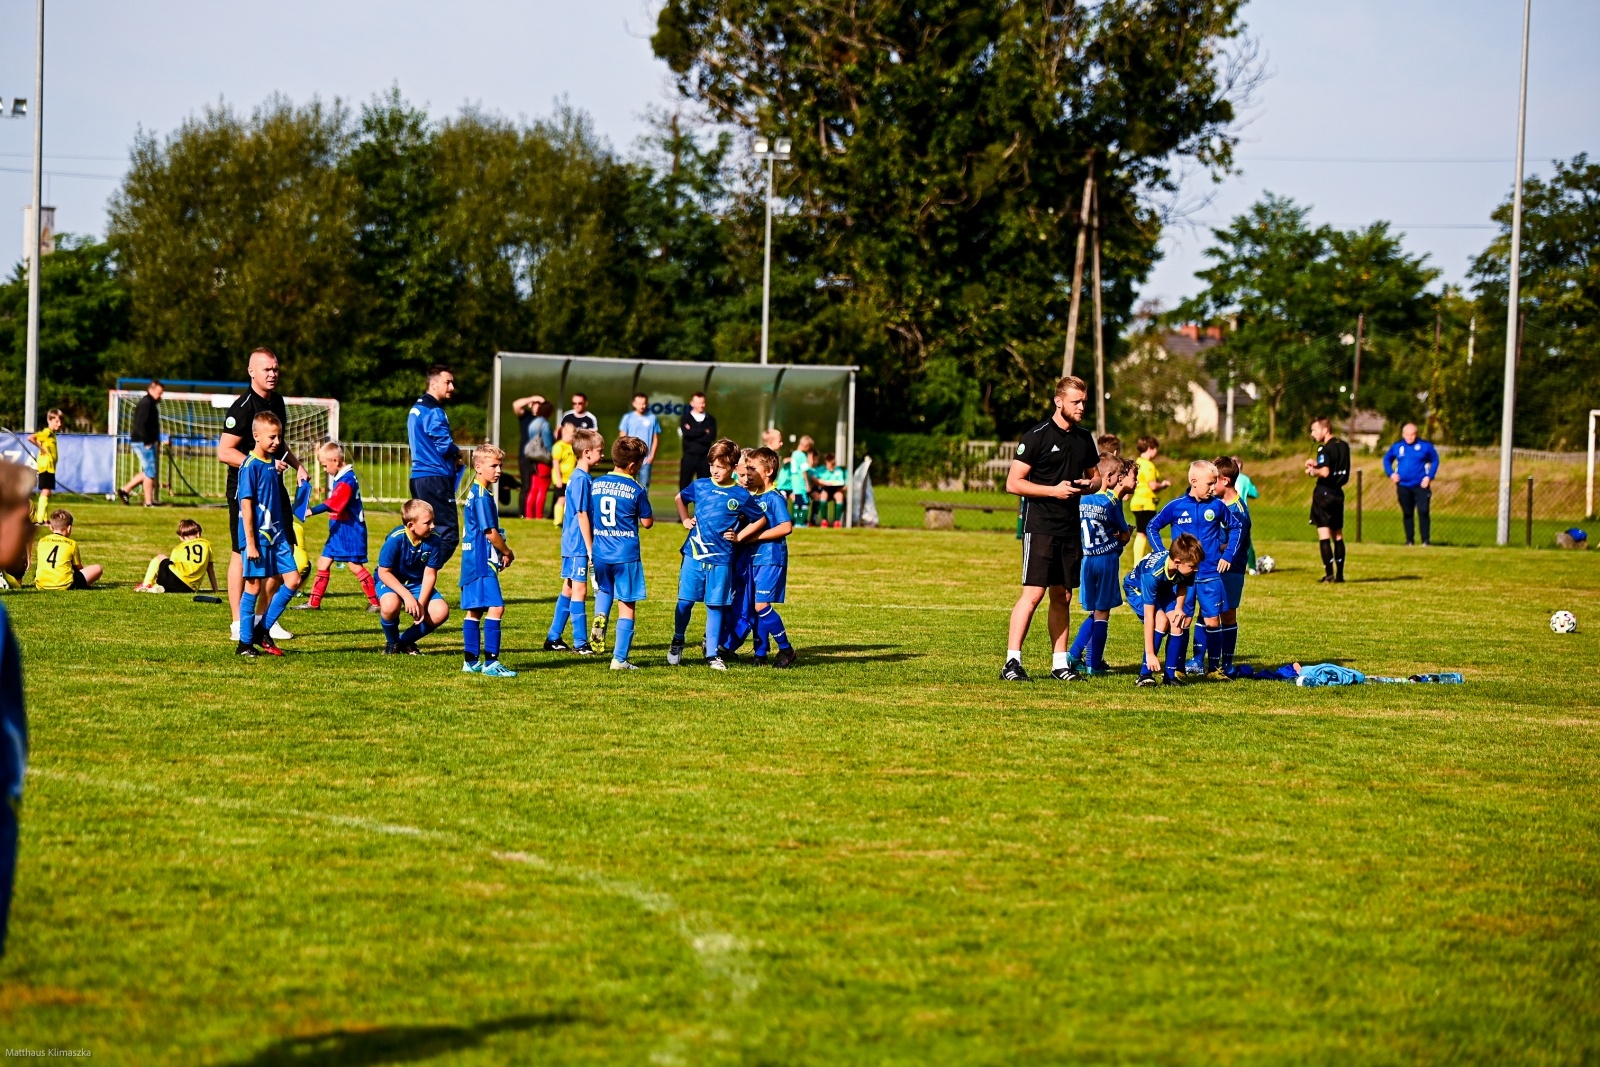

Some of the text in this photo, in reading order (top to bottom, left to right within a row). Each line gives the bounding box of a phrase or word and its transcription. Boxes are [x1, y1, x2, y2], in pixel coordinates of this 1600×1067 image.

[600, 496, 617, 527] 9
[1080, 519, 1109, 549] 13
[46, 545, 59, 569] 4
[184, 544, 203, 563] 19
[577, 567, 586, 576] 15
